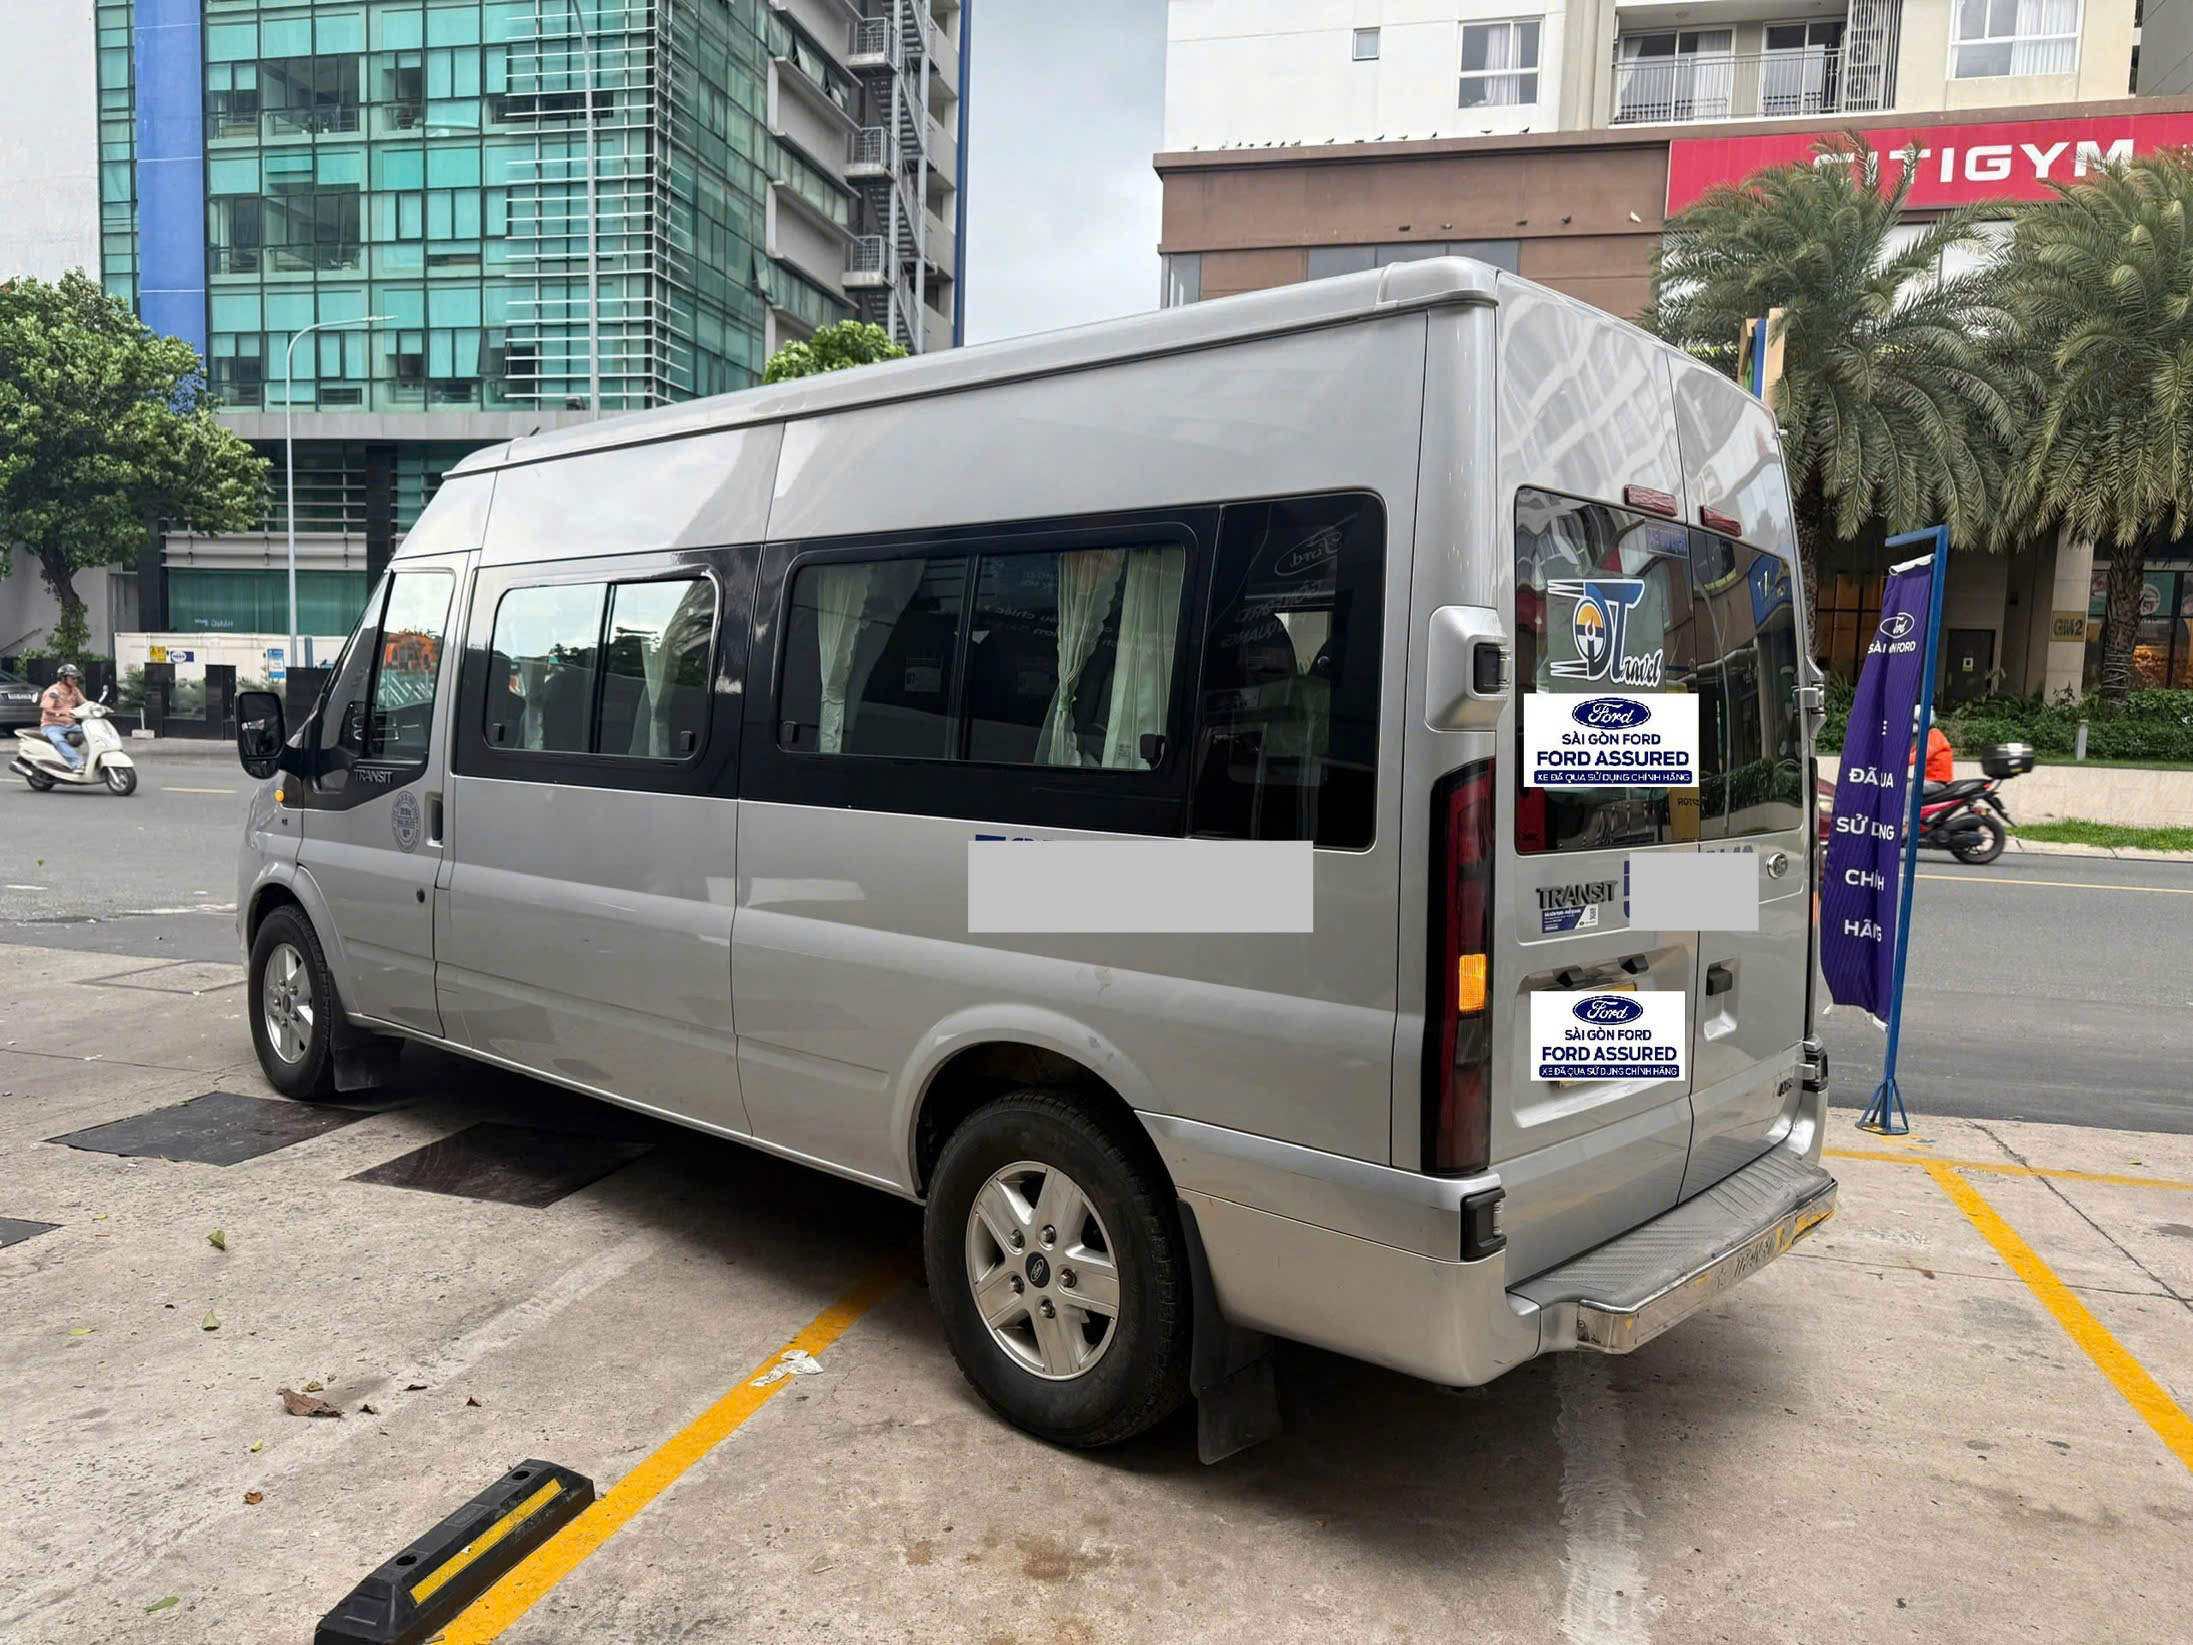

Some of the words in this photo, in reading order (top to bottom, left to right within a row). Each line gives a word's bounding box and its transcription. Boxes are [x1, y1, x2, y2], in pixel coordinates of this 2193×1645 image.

[354, 769, 393, 784] TRANSIT
[1836, 813, 1869, 834] SỬ
[1536, 880, 1618, 909] TRANSIT
